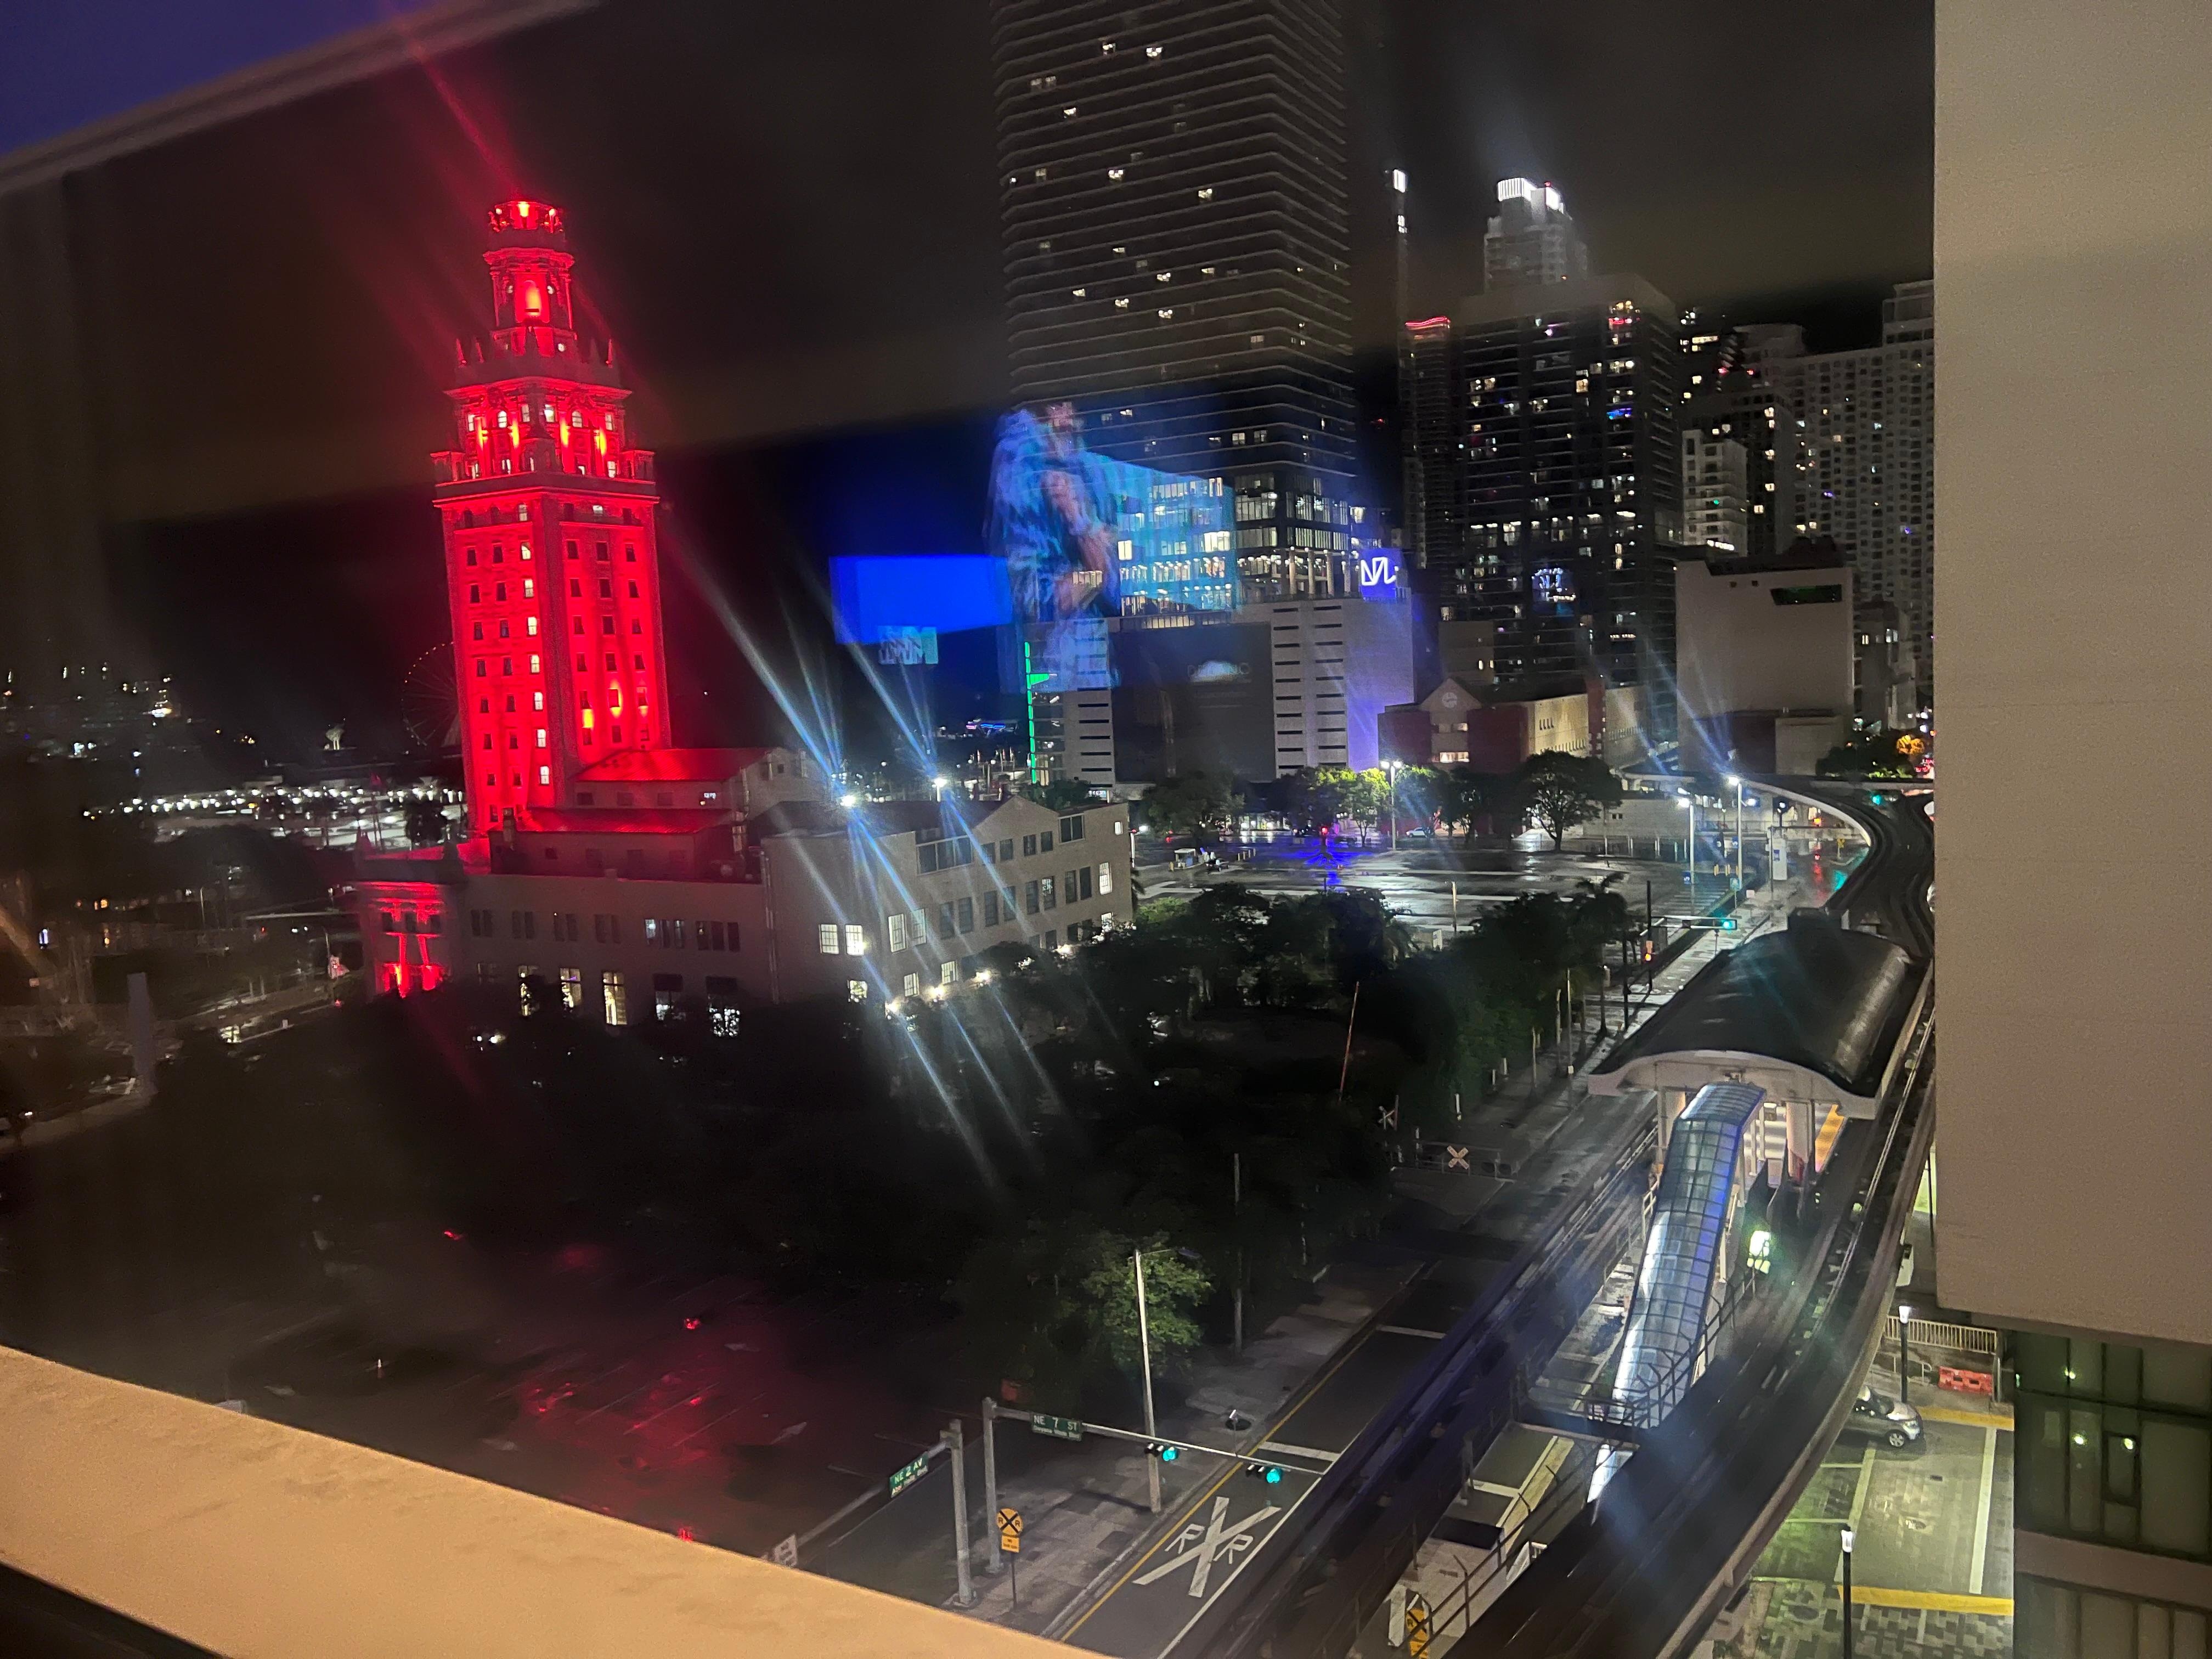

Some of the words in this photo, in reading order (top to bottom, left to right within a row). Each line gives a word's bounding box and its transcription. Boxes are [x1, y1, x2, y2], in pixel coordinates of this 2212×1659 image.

[1033, 1415, 1045, 1425] NE
[1052, 1417, 1058, 1427] 7
[1067, 1421, 1077, 1431] ST
[894, 1471, 904, 1484] NE
[905, 1466, 911, 1476] 2
[913, 1458, 922, 1471] AV
